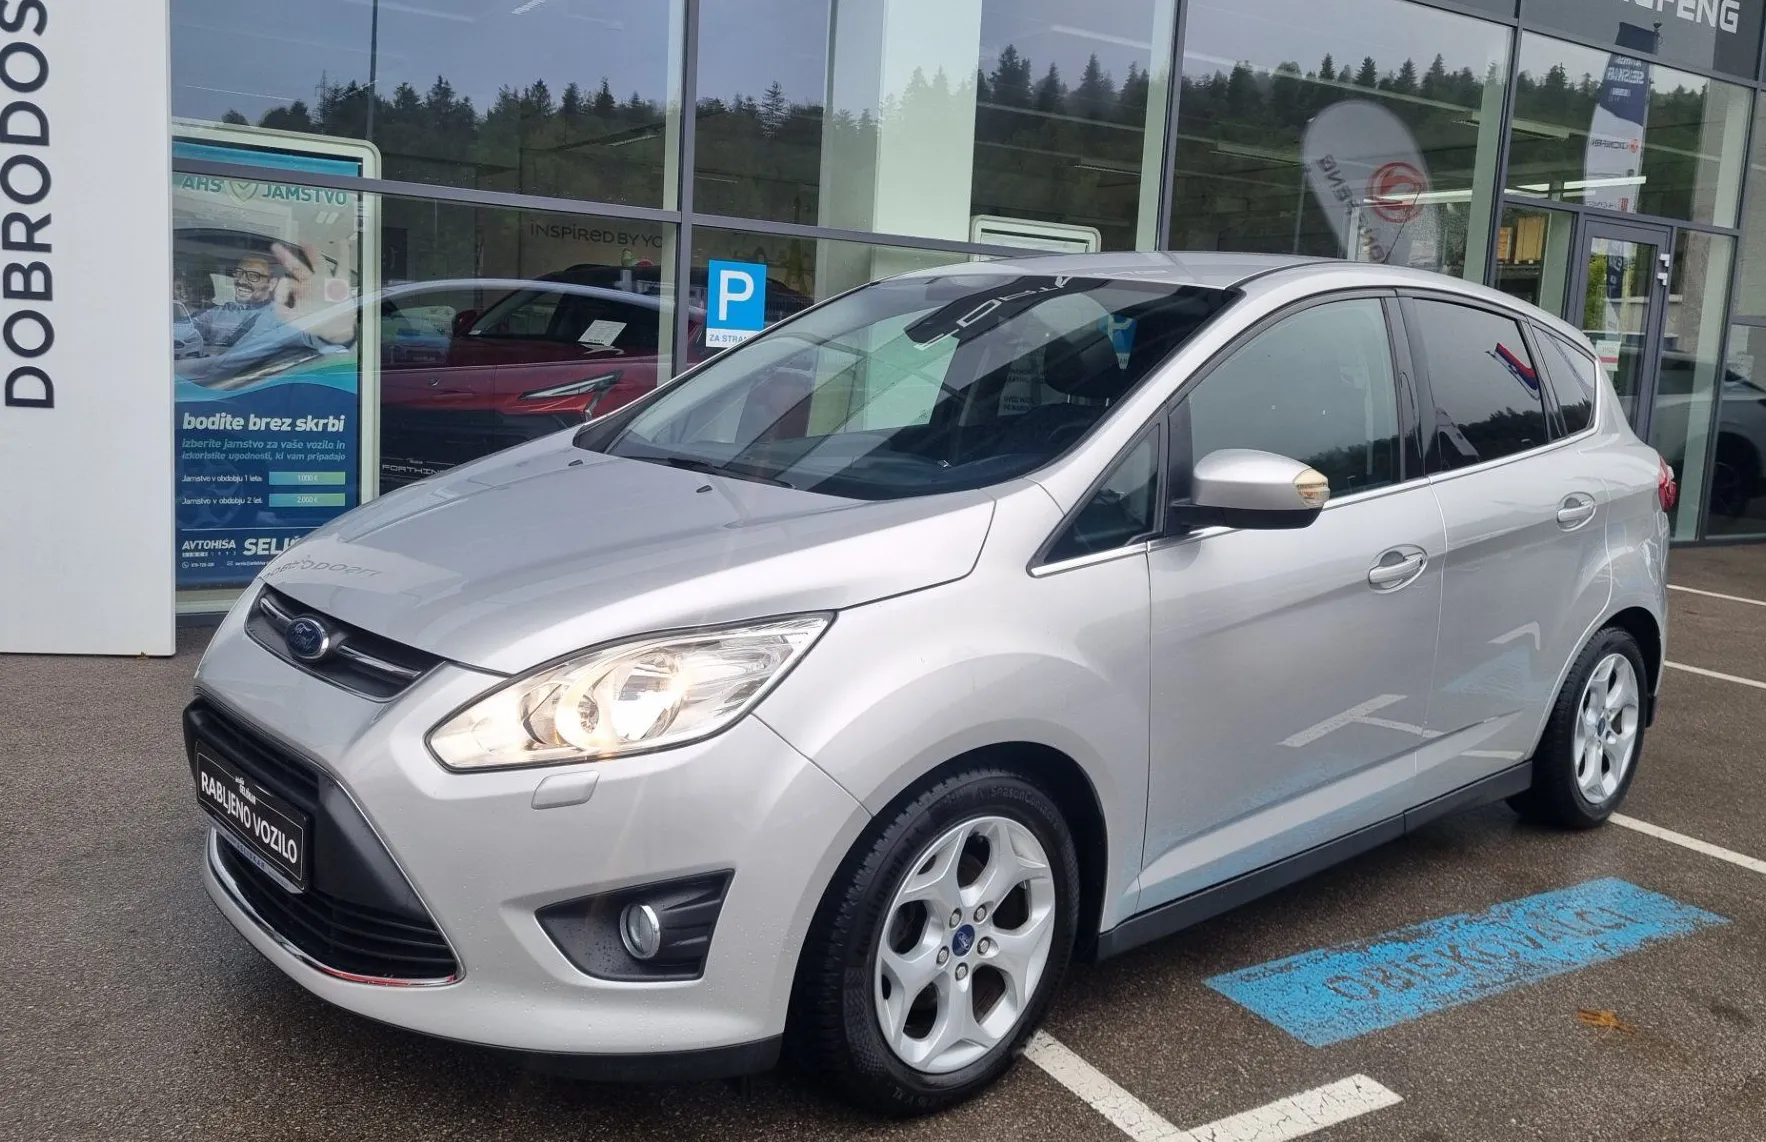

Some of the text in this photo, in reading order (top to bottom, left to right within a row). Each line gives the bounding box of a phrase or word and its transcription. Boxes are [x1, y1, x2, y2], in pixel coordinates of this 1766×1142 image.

[181, 175, 347, 206] AHS JAMSTVO
[617, 233, 639, 246] BY
[718, 269, 755, 321] P
[710, 334, 720, 342] ZA
[183, 412, 346, 432] bodite brez skrbi
[182, 438, 346, 450] izberite jamstvo za vaše vozilo in
[182, 451, 226, 460] izkoristite
[228, 452, 273, 461] ugodnosti,
[275, 452, 284, 460] ki
[307, 452, 346, 461] pripadajo
[182, 474, 211, 482] Jamstvo
[201, 771, 298, 864] RABLJENO VOZILO
